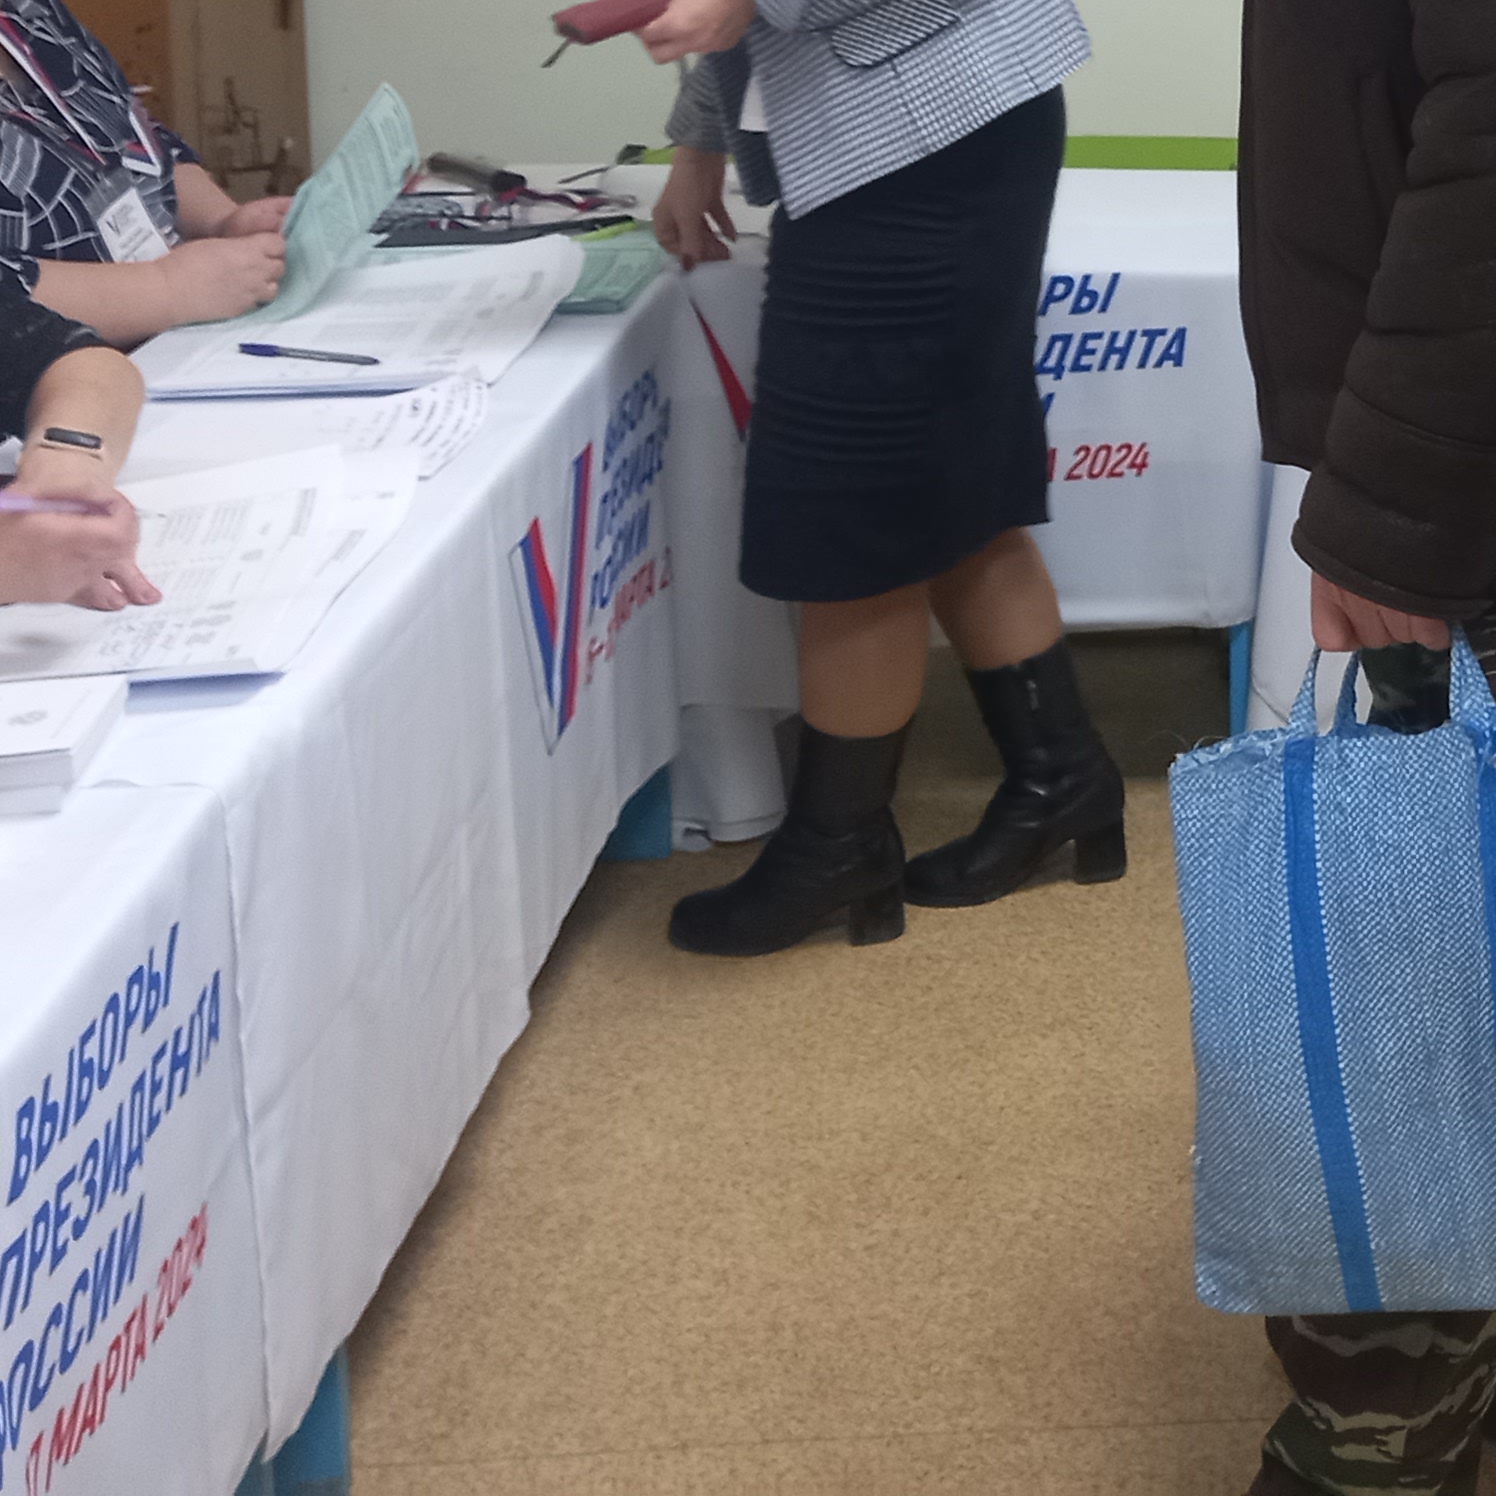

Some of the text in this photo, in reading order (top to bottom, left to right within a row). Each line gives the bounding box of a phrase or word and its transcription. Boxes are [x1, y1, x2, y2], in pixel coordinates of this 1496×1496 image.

[1034, 326, 1188, 381] ДЕНТА
[1037, 271, 1121, 318] РЫ
[1063, 441, 1150, 482] 2024
[8, 921, 179, 1204] ВЫБОРЫ
[0, 968, 221, 1332] ПРЕЗИДЕНТА
[46, 1291, 149, 1494] МАРТА
